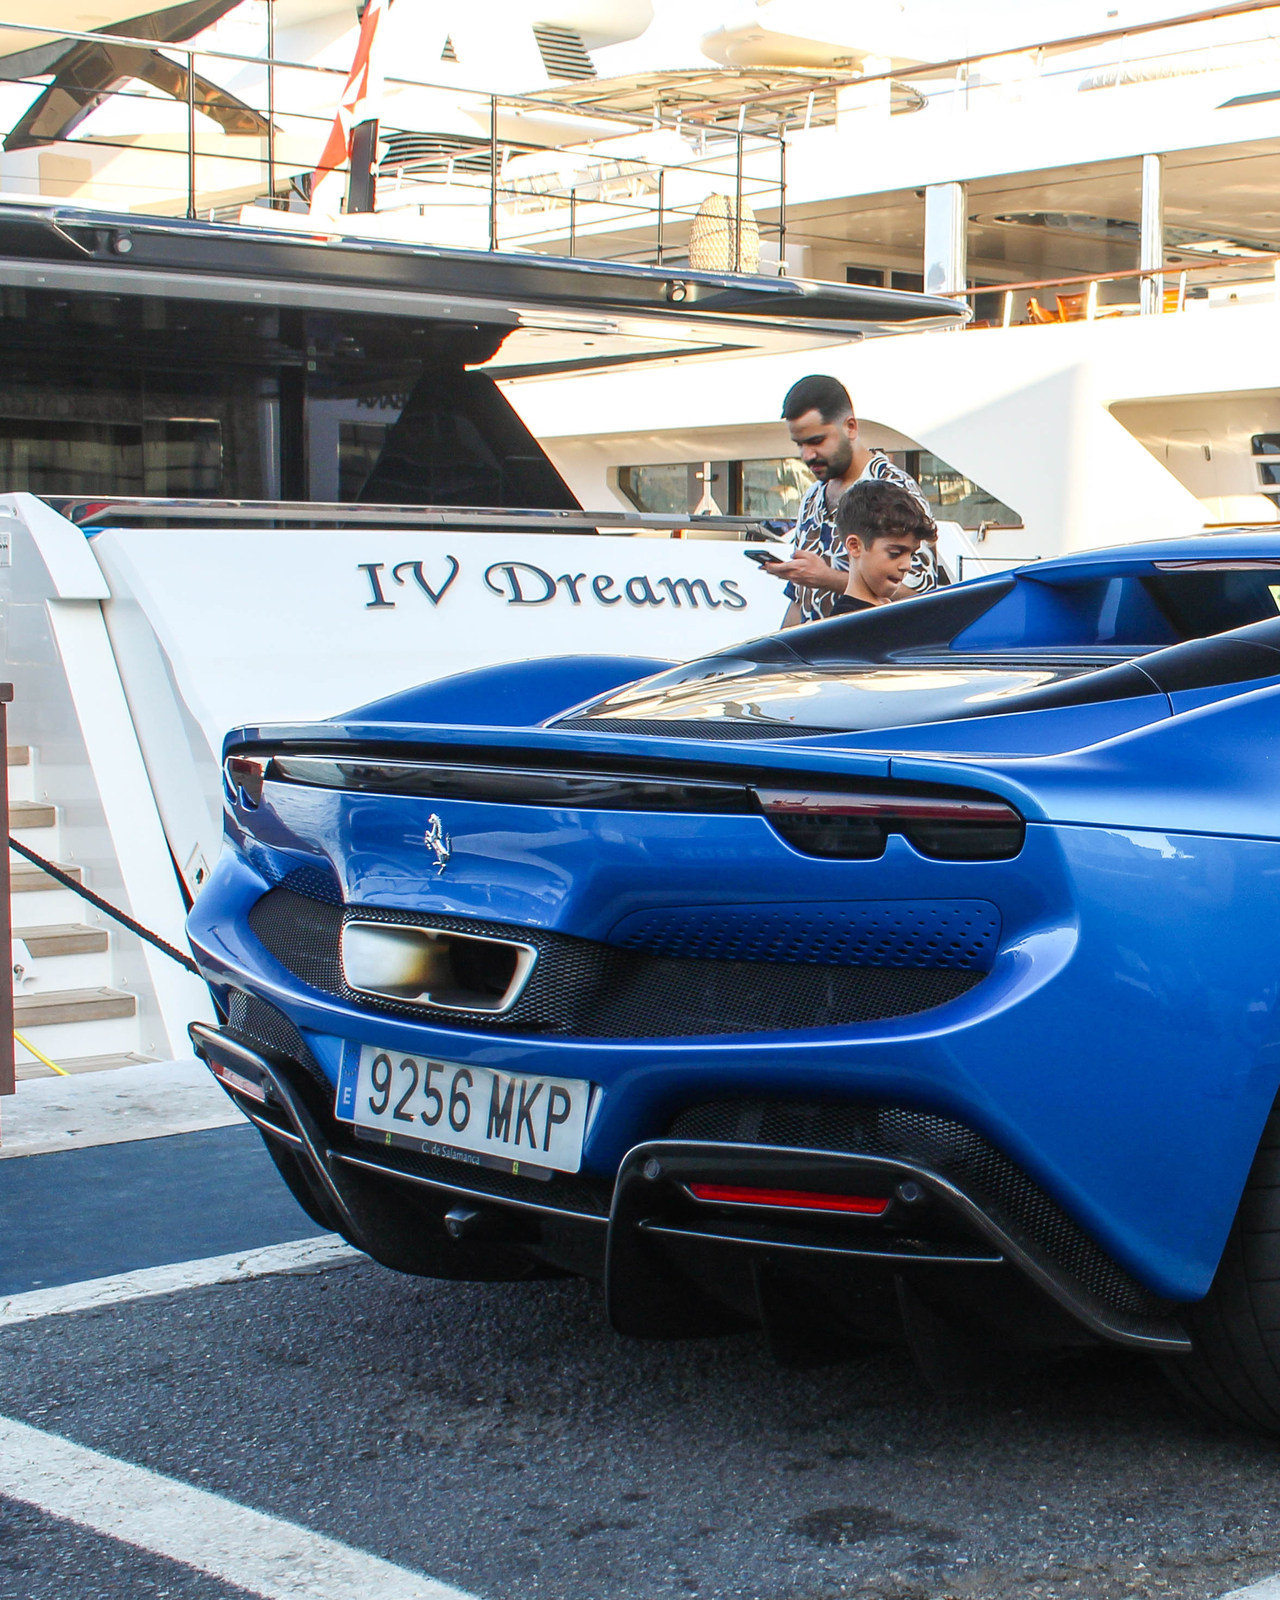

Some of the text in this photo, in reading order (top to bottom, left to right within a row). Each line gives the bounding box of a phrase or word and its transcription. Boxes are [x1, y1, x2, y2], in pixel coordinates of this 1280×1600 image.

[357, 555, 748, 611] IV Dreams
[343, 1053, 572, 1152] E 9256 MKP
[421, 1141, 480, 1165] C. de Salamanca
